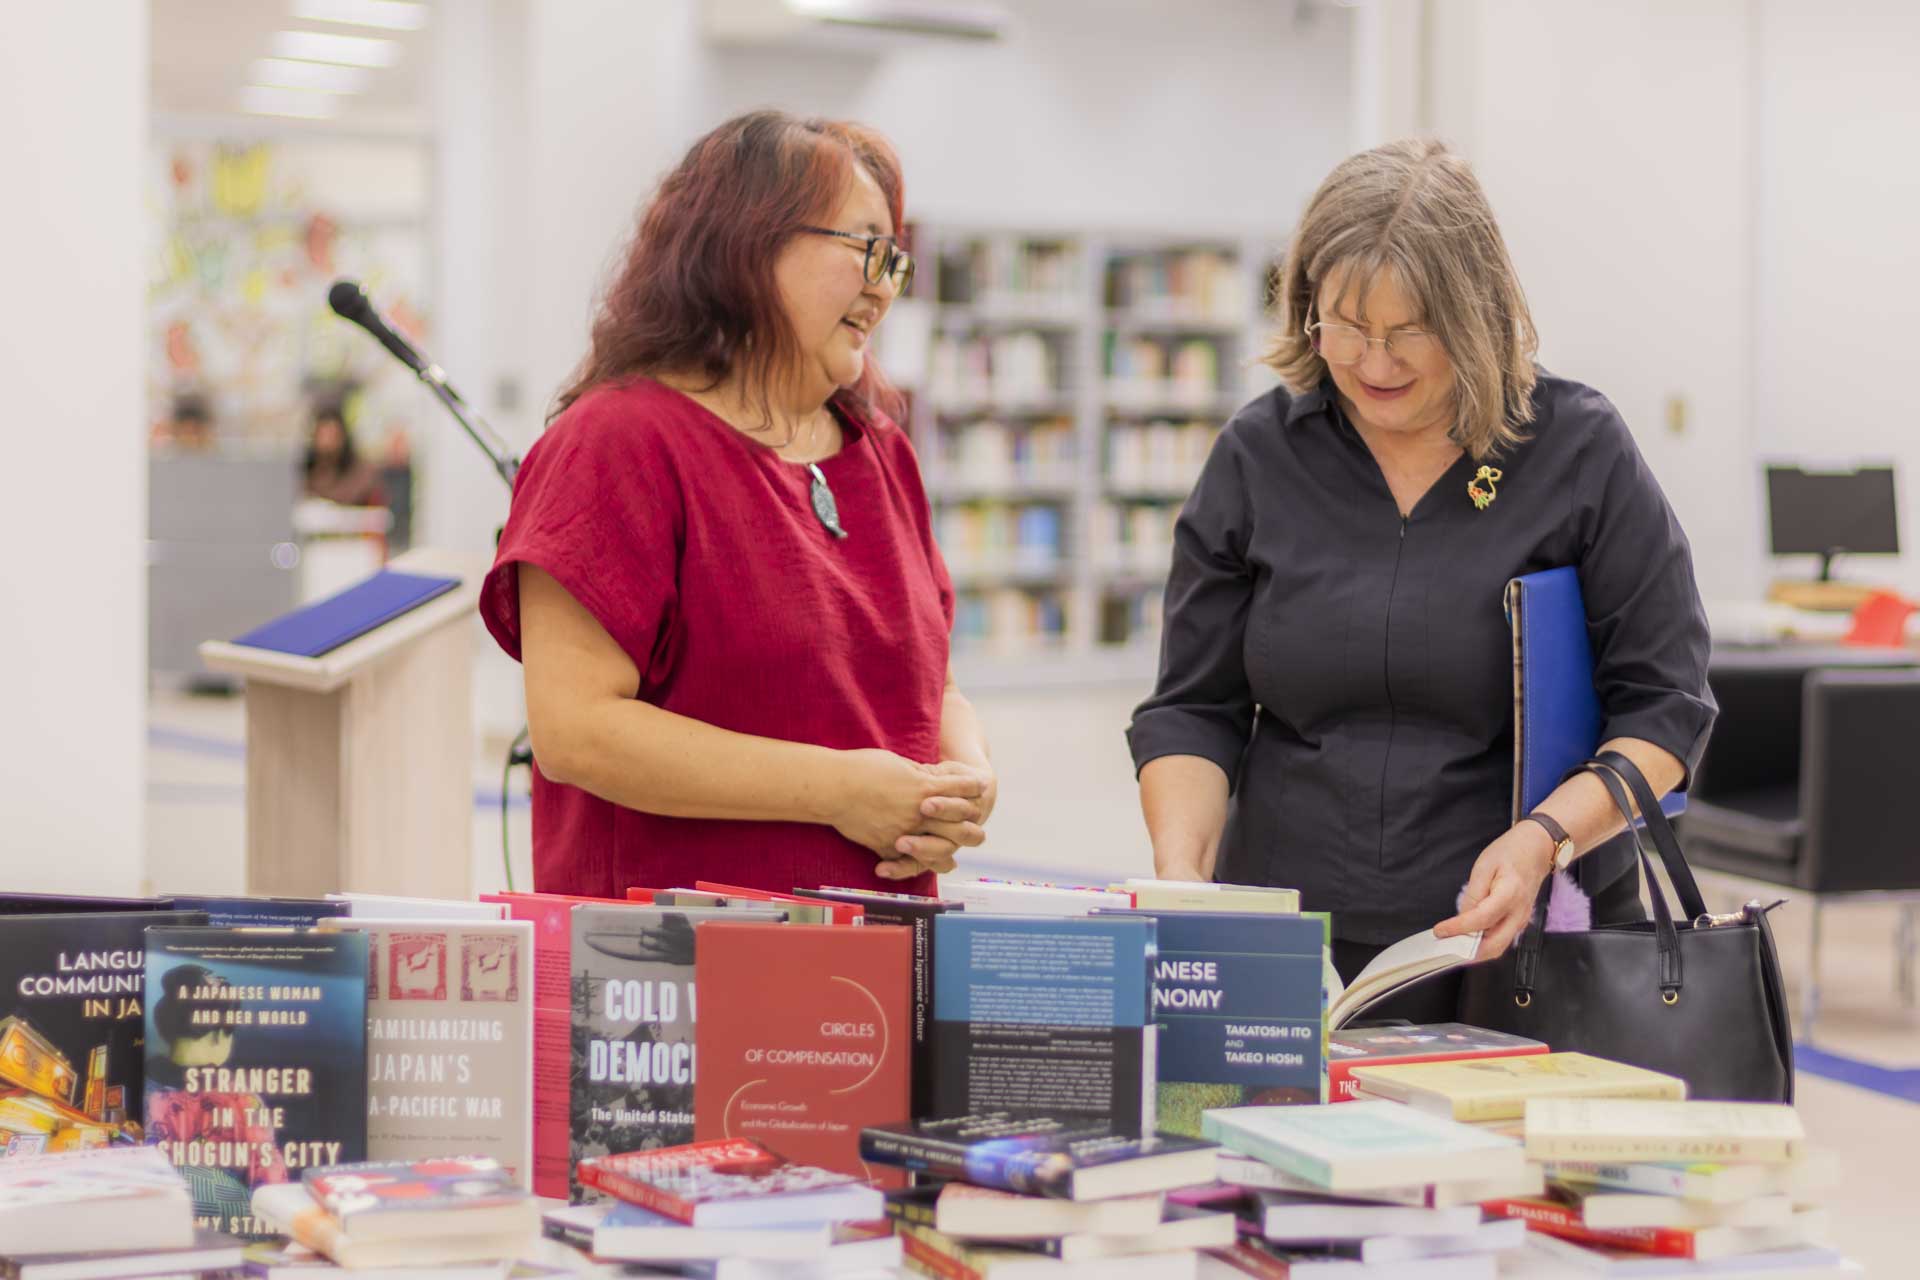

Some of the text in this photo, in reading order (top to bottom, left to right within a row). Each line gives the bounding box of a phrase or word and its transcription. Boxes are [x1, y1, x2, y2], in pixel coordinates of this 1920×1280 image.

[59, 950, 144, 971] LANGU
[19, 974, 144, 996] COMMUNI
[915, 917, 925, 1041] Modern Japanese Culture
[178, 985, 321, 1001] A JAPANESE WOMAN
[605, 979, 678, 1023] COLD
[1154, 988, 1223, 1009] NOMY
[84, 998, 142, 1019] IN JA
[192, 1010, 307, 1025] AND HER WORLD
[820, 1022, 875, 1038] CIRCLES
[1225, 1025, 1312, 1039] TAKATOSHI ITO
[1225, 1040, 1244, 1049] AND
[590, 1039, 696, 1085] DEMOC
[745, 1048, 874, 1067] OF COMPENSATION
[1225, 1052, 1303, 1066] TAKEO HOSHI
[372, 1053, 471, 1085] JAPAN'S
[185, 1067, 311, 1095] STRANGER
[369, 1095, 503, 1119] A-PACIFIC WAR
[591, 1107, 613, 1121] The
[615, 1108, 656, 1123] United
[740, 1100, 777, 1112] Economic
[212, 1107, 283, 1128] IN THE
[284, 1141, 341, 1168] CITY
[1506, 1202, 1567, 1227] DYNASTIES
